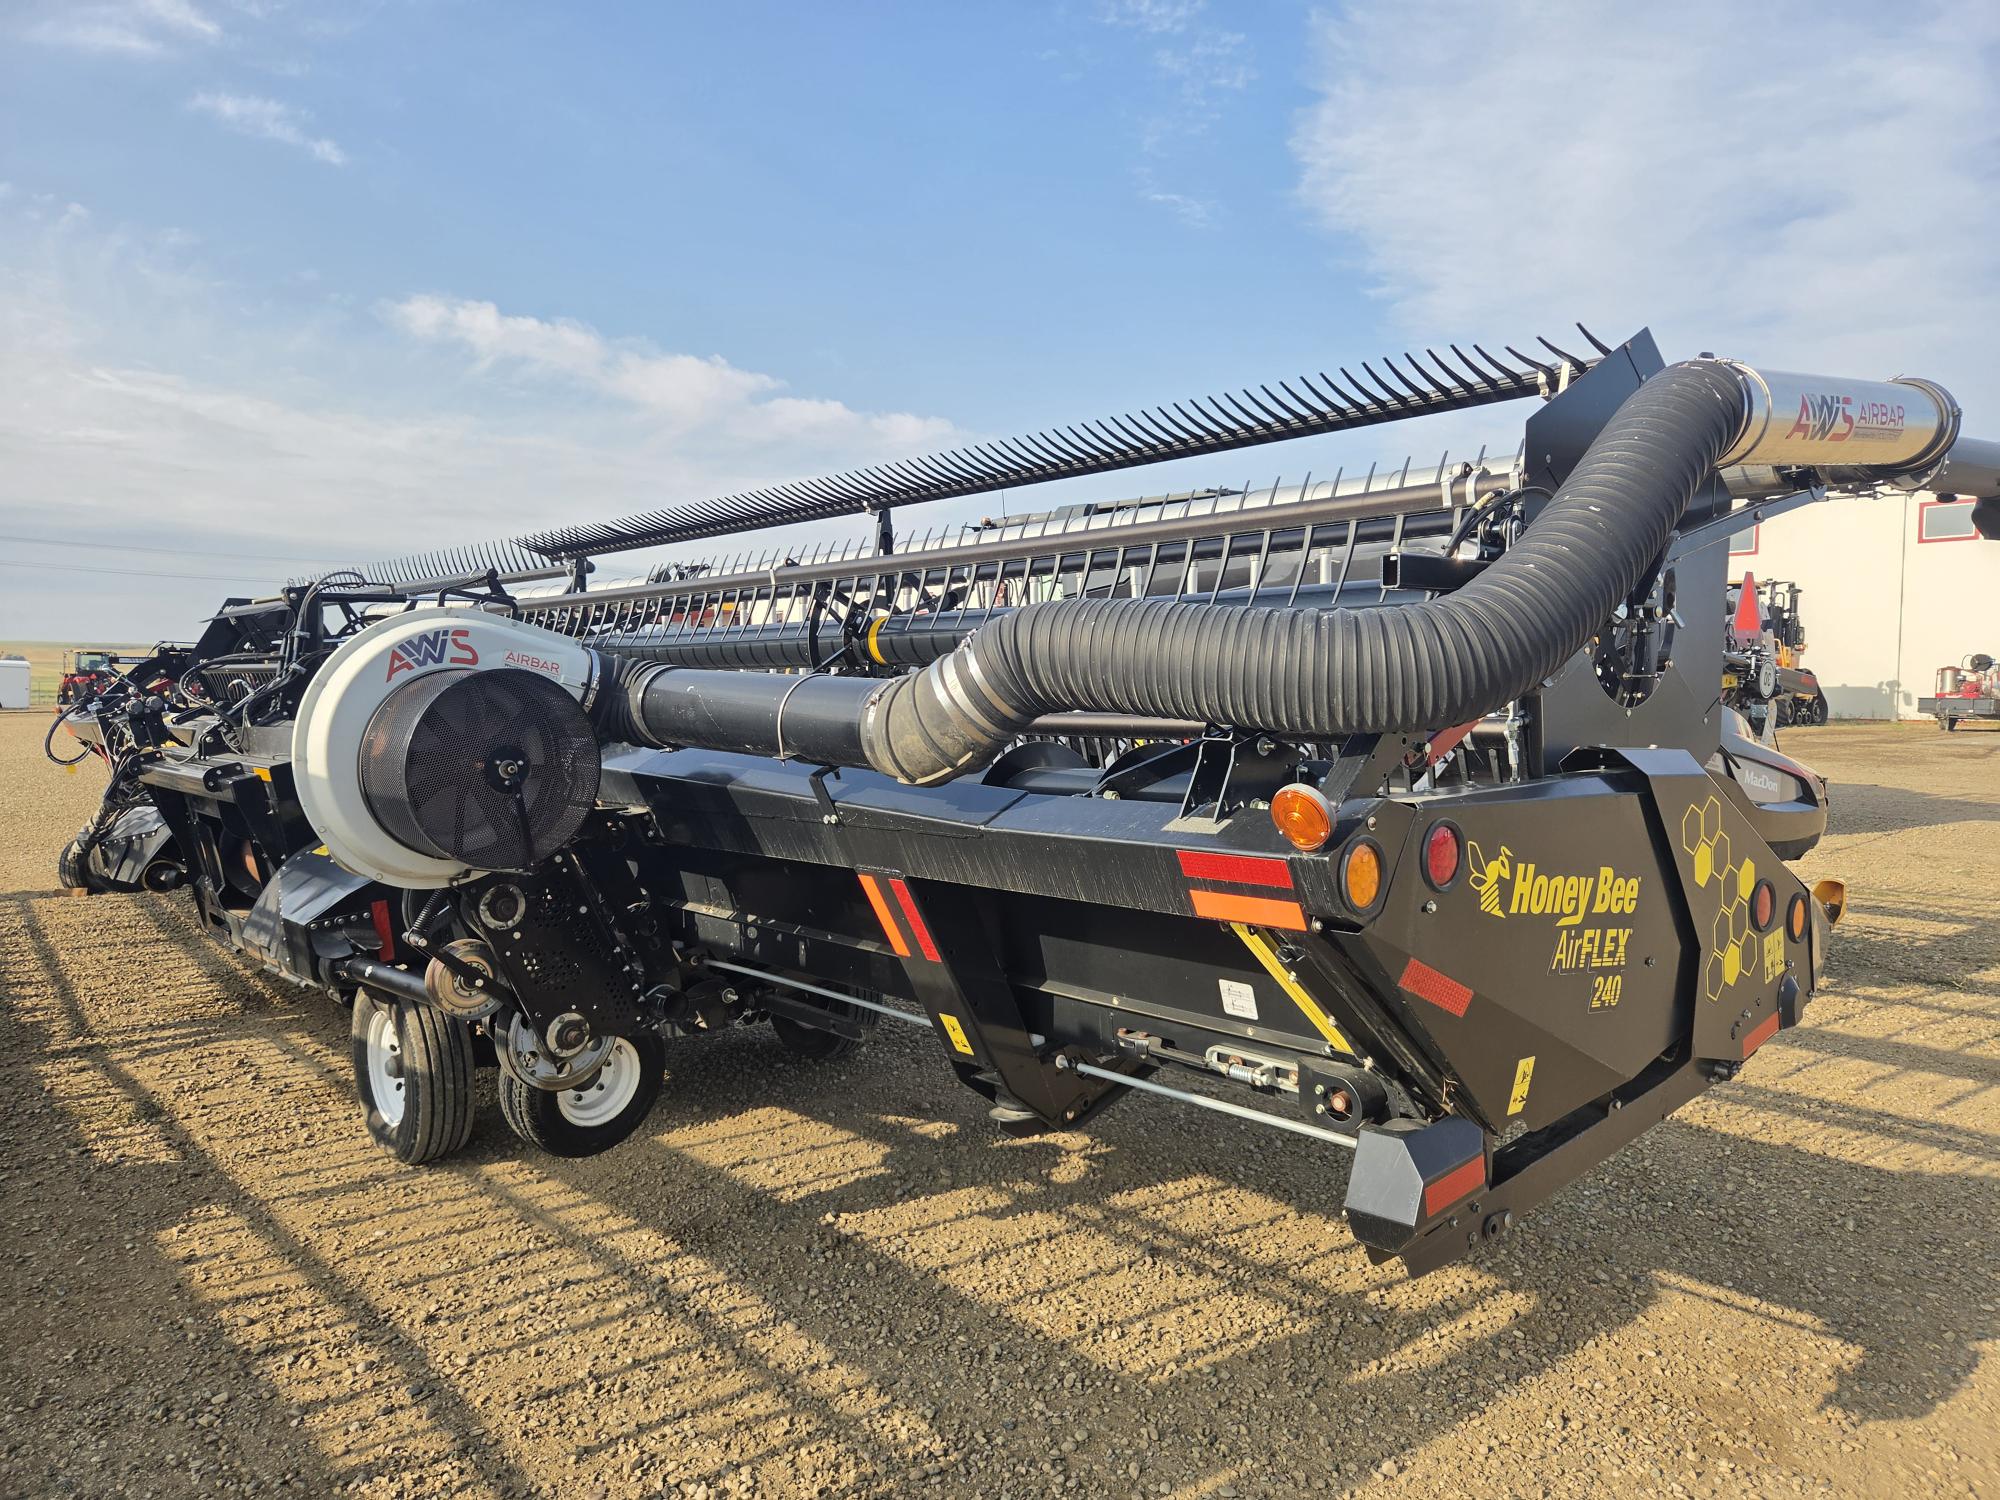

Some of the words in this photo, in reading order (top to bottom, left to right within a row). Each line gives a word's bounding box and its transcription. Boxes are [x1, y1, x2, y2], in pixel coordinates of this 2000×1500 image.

[1784, 393, 1855, 442] AWS
[1857, 401, 1905, 427] AIRBAR
[386, 629, 479, 683] AWS
[505, 650, 560, 674] AIRBAR
[1744, 769, 1778, 793] MacDon
[1509, 863, 1594, 927] Honey
[1592, 866, 1639, 914] Bee
[1551, 927, 1631, 970] AirFLEX
[1591, 975, 1622, 1008] 240
